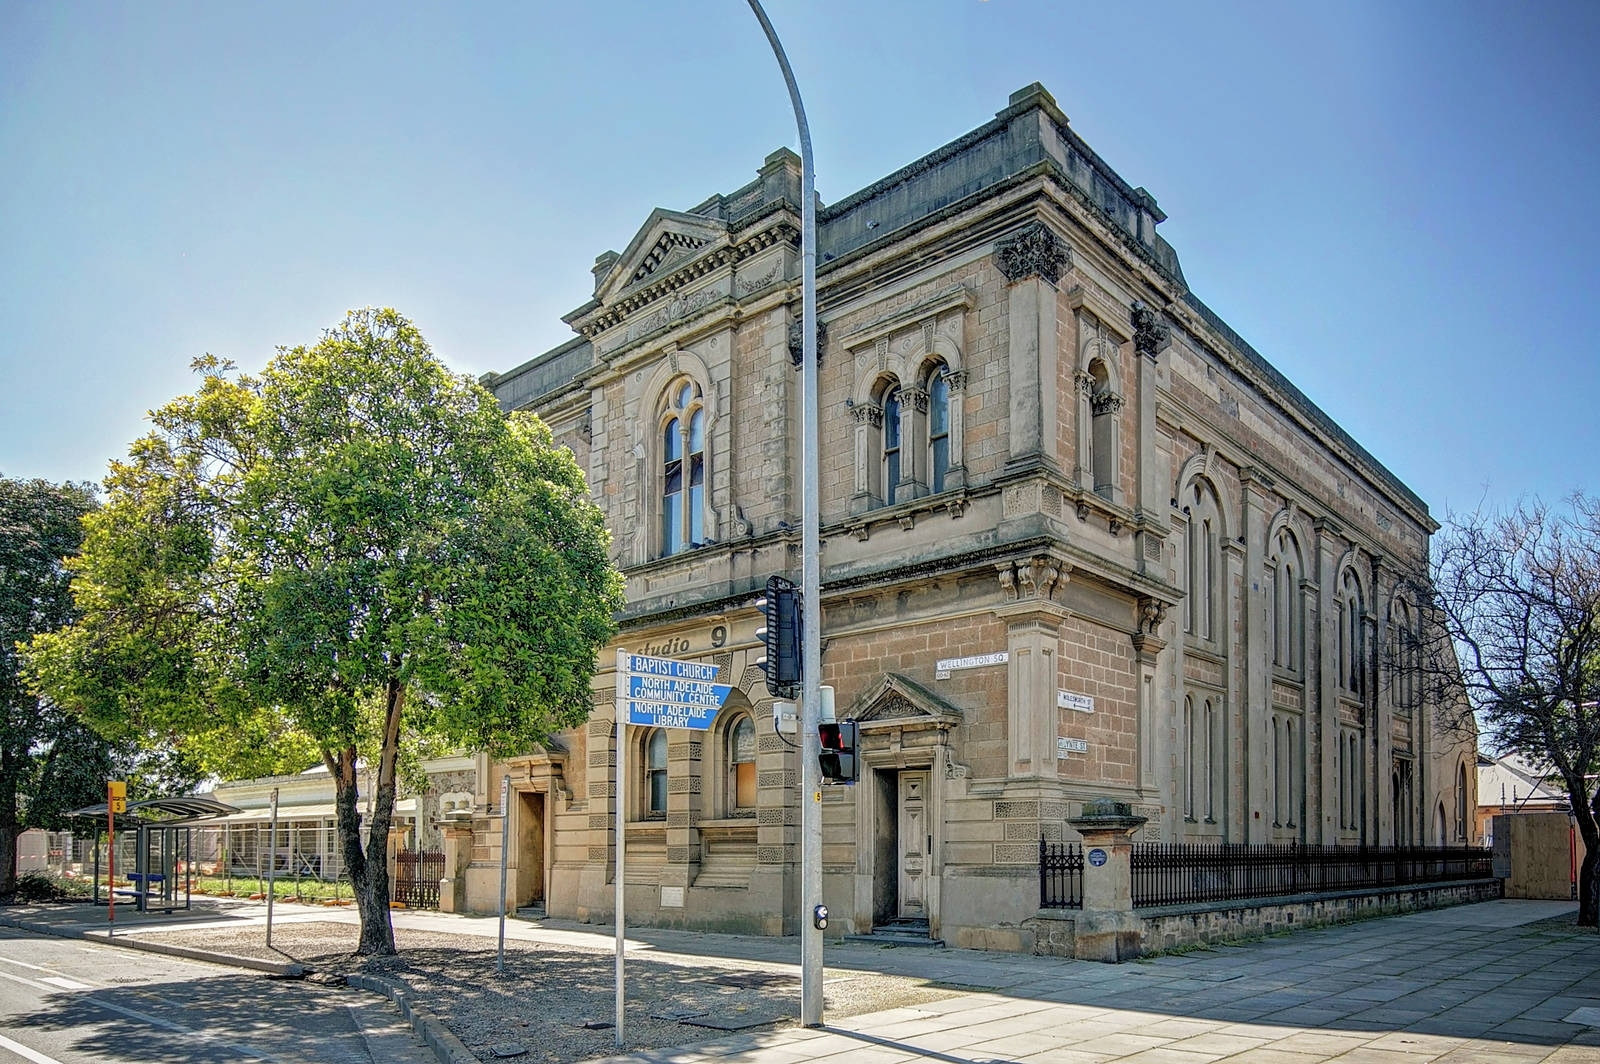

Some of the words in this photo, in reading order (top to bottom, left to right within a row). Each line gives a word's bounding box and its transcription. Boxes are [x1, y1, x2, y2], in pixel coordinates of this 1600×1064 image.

[637, 637, 690, 657] studio
[711, 625, 727, 648] 9
[635, 656, 672, 675] BAPTIST
[676, 663, 713, 680] CHURCH
[940, 656, 990, 669] WELLINGTON
[641, 678, 670, 691] NORTH
[674, 681, 714, 695] ADELAIDE
[634, 687, 685, 703] COMMUNITY
[689, 693, 720, 706] CENTRE
[634, 702, 663, 715] NORTH
[666, 706, 707, 719] ADELAIDE
[653, 715, 689, 727] LIBRARY
